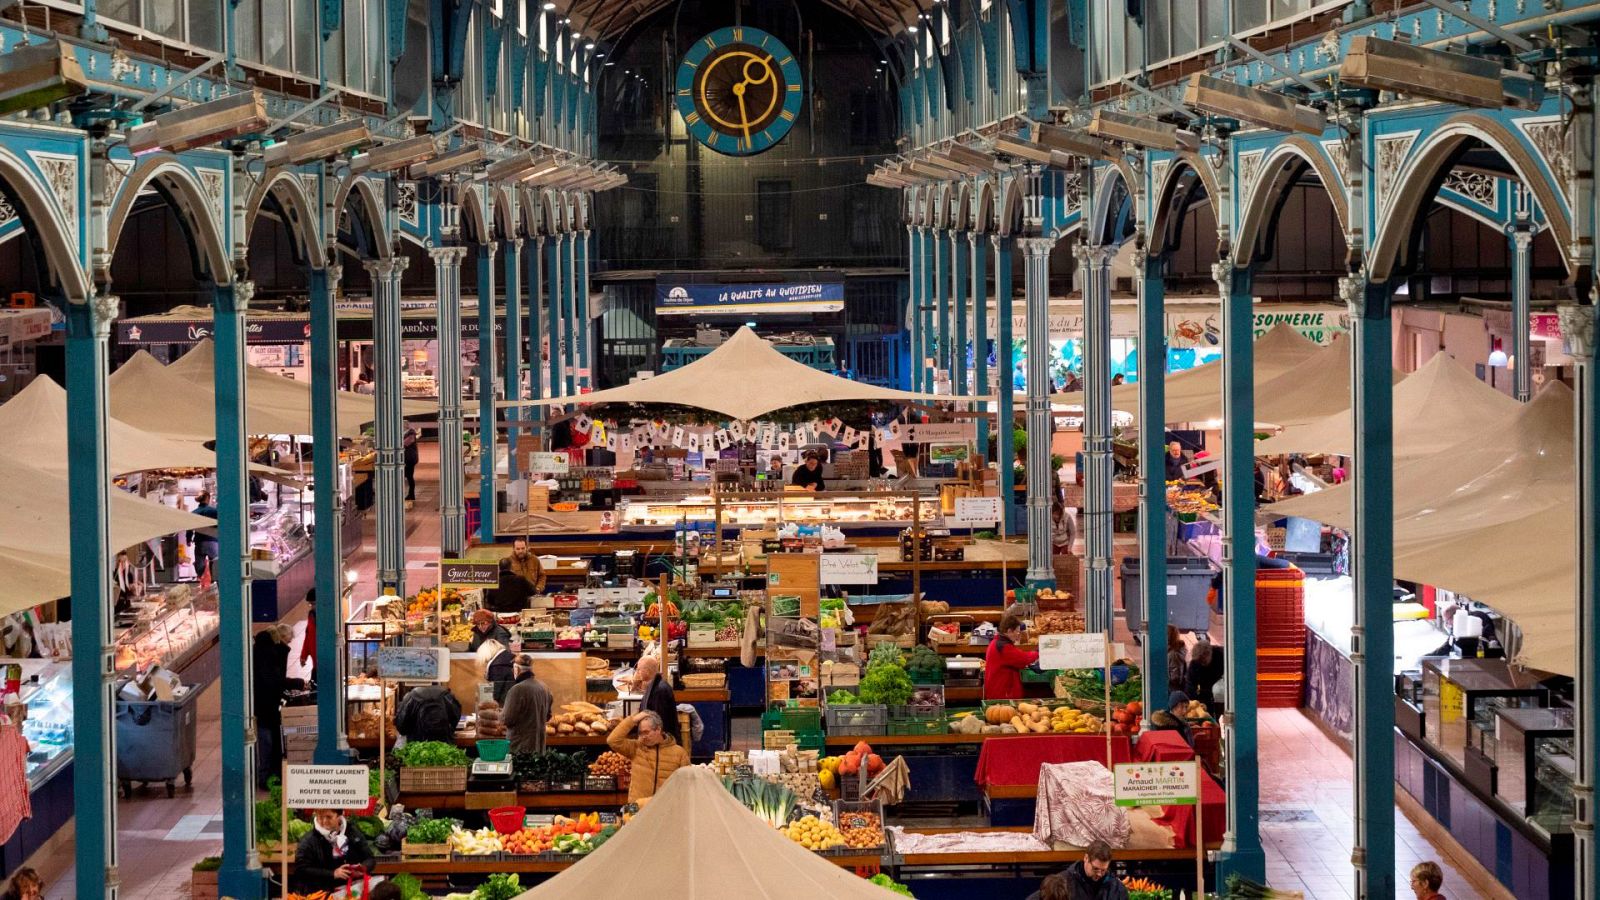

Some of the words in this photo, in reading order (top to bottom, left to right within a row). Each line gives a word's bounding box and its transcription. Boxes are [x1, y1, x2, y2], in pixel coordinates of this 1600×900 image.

[719, 292, 728, 302] LA
[765, 289, 776, 297] AU
[780, 285, 822, 296] QUOTIDIEN
